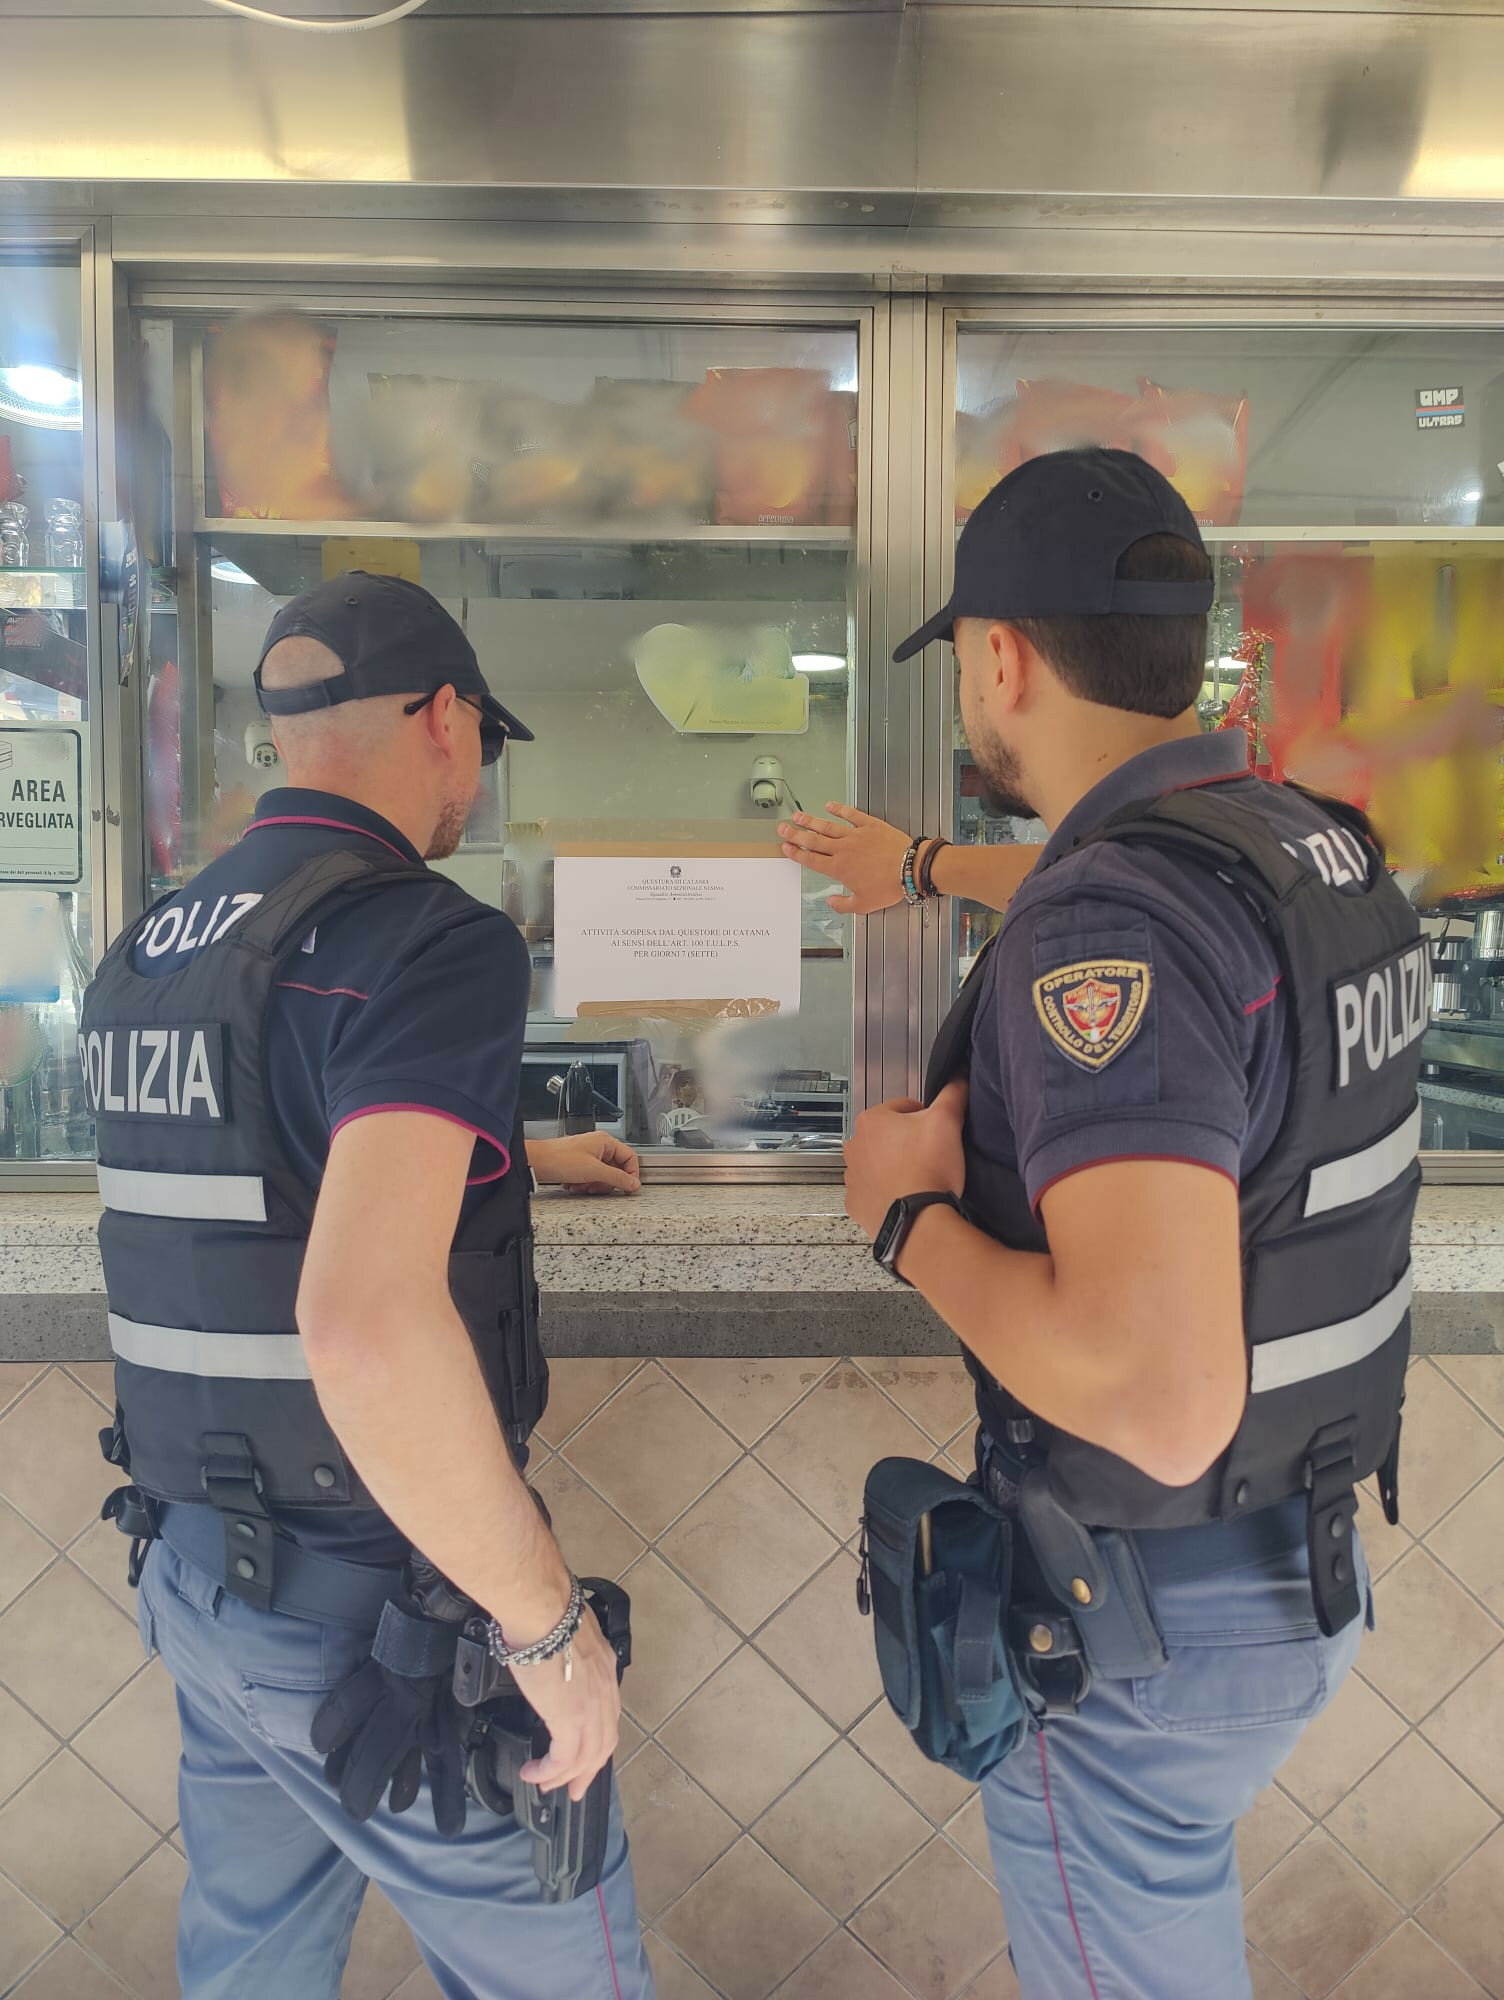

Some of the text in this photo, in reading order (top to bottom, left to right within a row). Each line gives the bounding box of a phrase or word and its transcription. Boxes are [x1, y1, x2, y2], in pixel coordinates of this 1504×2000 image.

[1418, 414, 1463, 428] ULTRAS
[11, 779, 66, 802] AREA
[621, 927, 657, 936] SOSPESA
[659, 928, 676, 936] DAL
[677, 928, 721, 937] QUESTORE
[722, 928, 731, 936] DI
[733, 928, 770, 937] CATANIA
[611, 939, 620, 947] AI
[621, 939, 645, 947] SENSI
[691, 939, 704, 947] 100
[633, 950, 649, 958] PER
[650, 950, 680, 958] GIORNI
[687, 950, 719, 959] (SETTE)
[1043, 967, 1139, 992] OPERATORE
[1043, 980, 1142, 1054] CONTROLLO DEL TERRITORIO
[77, 1029, 221, 1118] POLIZIA
